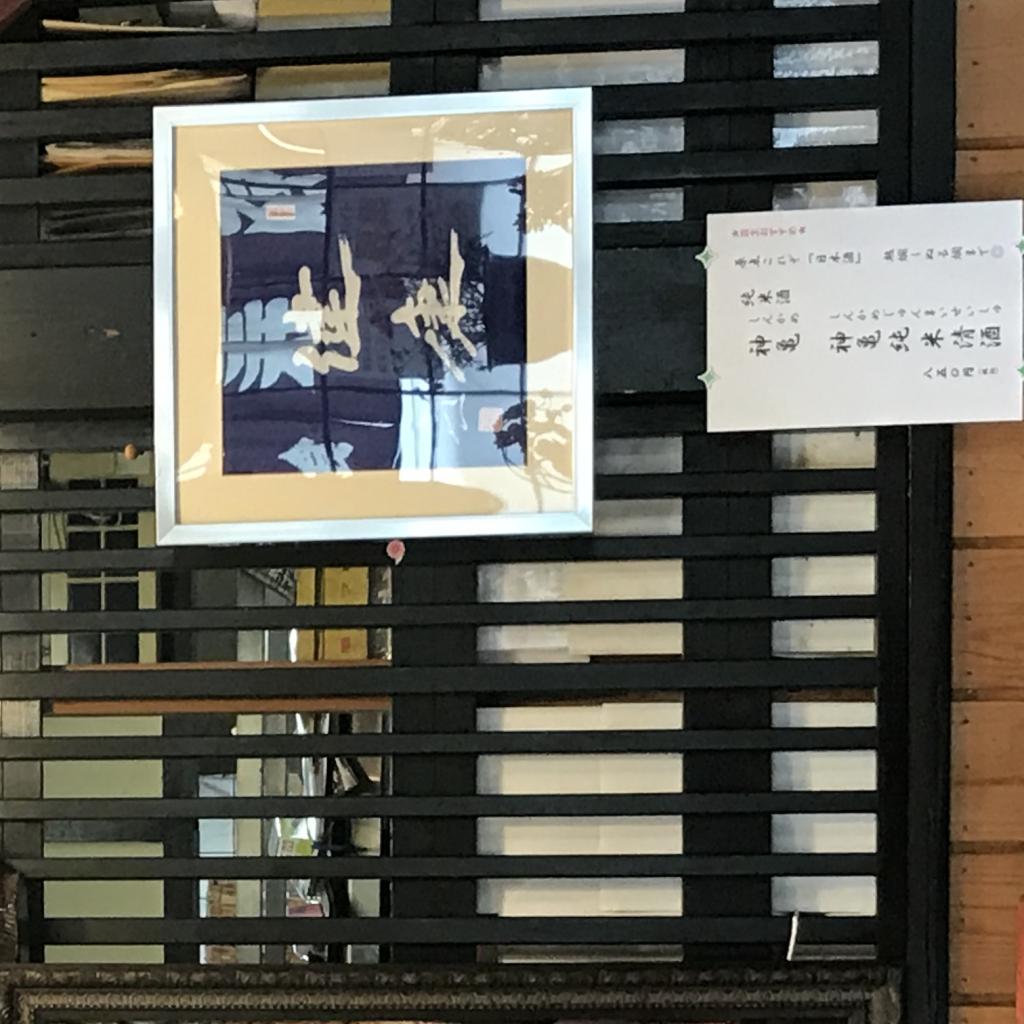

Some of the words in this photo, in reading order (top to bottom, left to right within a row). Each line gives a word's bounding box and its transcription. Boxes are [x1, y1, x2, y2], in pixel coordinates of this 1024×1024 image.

[740, 289, 791, 307] 純米酒
[748, 313, 799, 325] しんかめ
[748, 333, 800, 357] 神亀
[829, 325, 1002, 354] 神亀純米清酒
